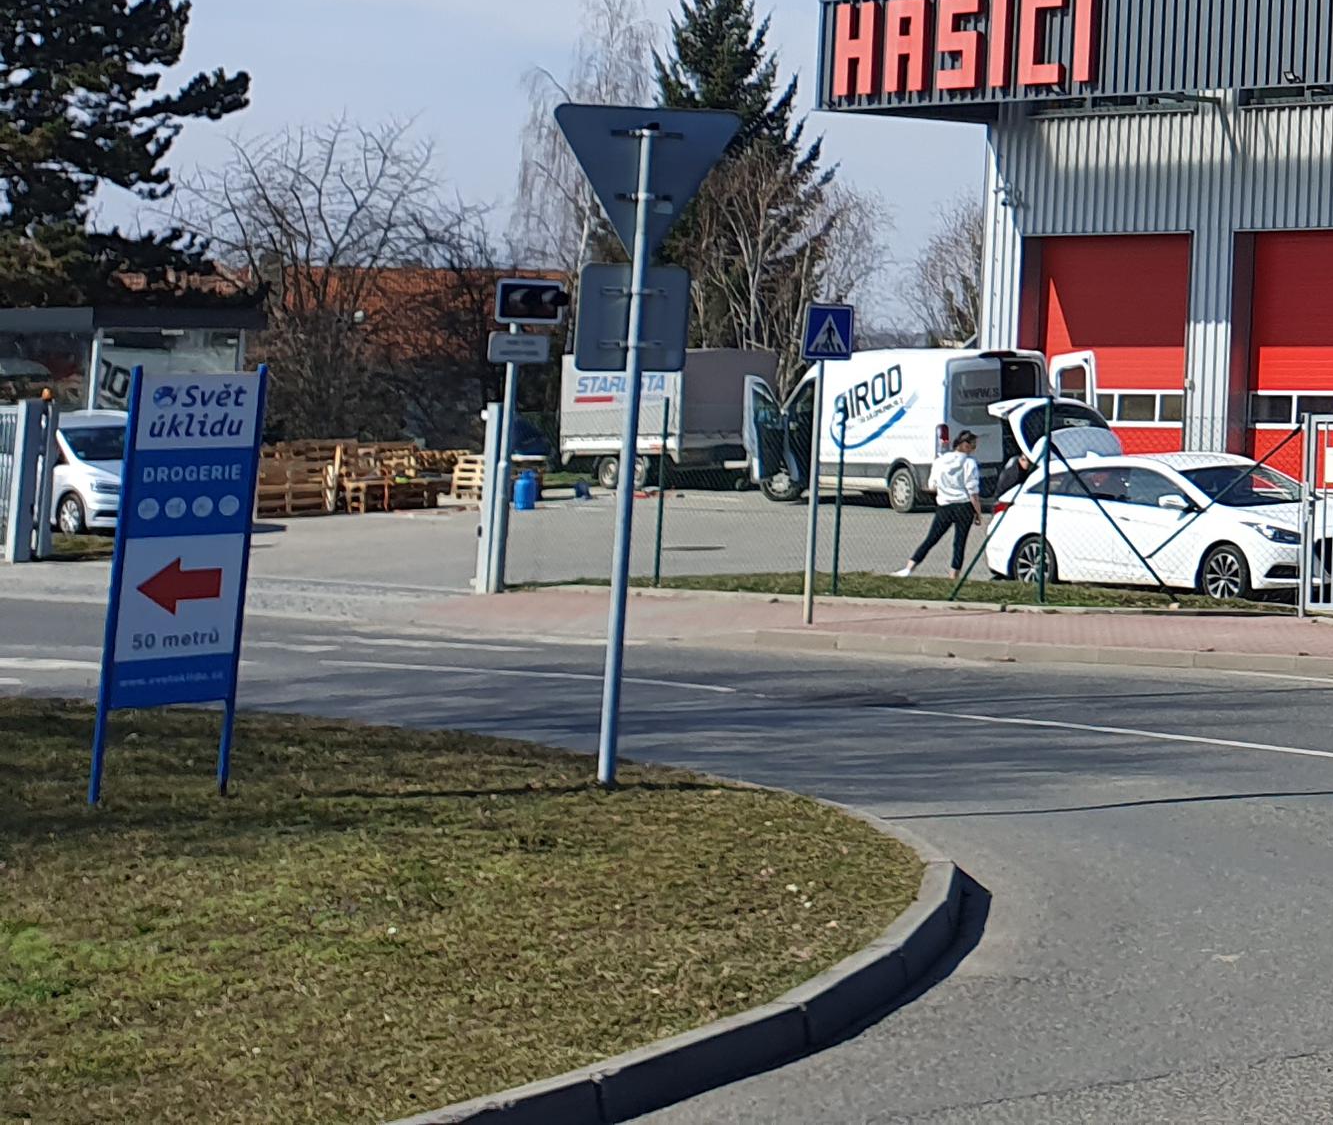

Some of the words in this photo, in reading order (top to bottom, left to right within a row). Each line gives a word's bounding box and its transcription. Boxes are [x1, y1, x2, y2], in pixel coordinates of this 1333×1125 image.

[181, 382, 247, 408] Svět
[149, 412, 243, 438] úklidu
[143, 463, 242, 483] DROGERIE
[132, 633, 156, 650] 50
[163, 627, 220, 648] metrů
